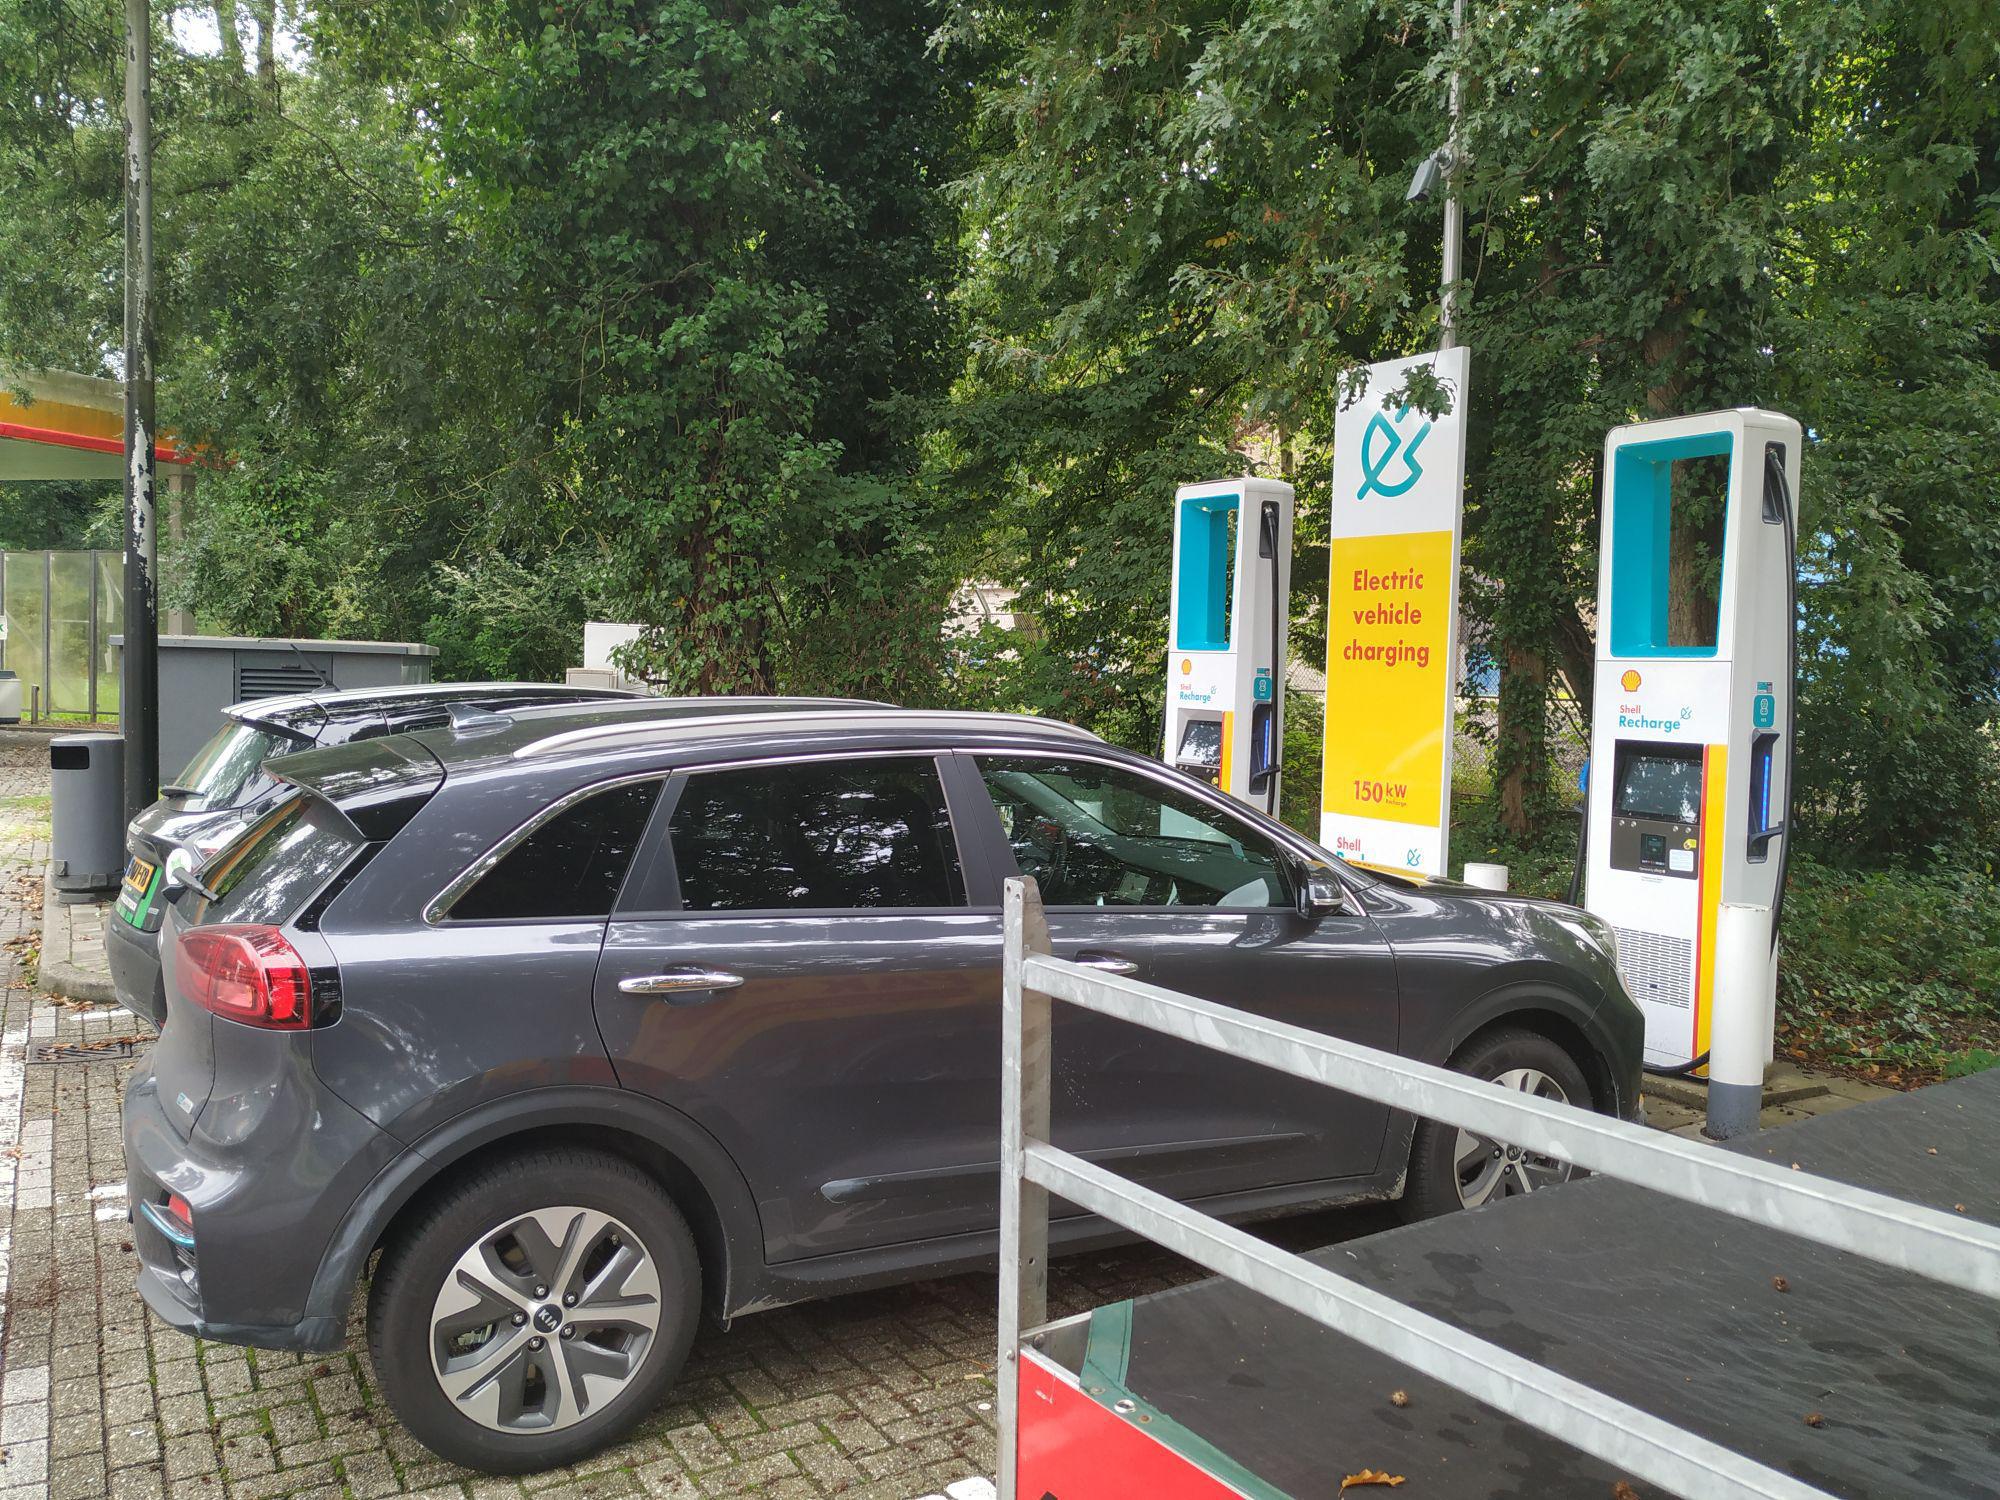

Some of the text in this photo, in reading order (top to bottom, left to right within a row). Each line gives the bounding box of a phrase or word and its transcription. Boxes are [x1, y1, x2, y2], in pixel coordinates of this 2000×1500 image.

[1353, 567, 1424, 591] Electric
[1353, 602, 1422, 625] vehicle
[1343, 638, 1430, 668] charging
[1180, 691, 1211, 703] Recharge
[1619, 704, 1641, 714] Shell
[1619, 715, 1680, 732] Recharge
[1354, 780, 1407, 803] 150 kW
[1336, 836, 1361, 852] Shell
[538, 1308, 558, 1330] KIA
